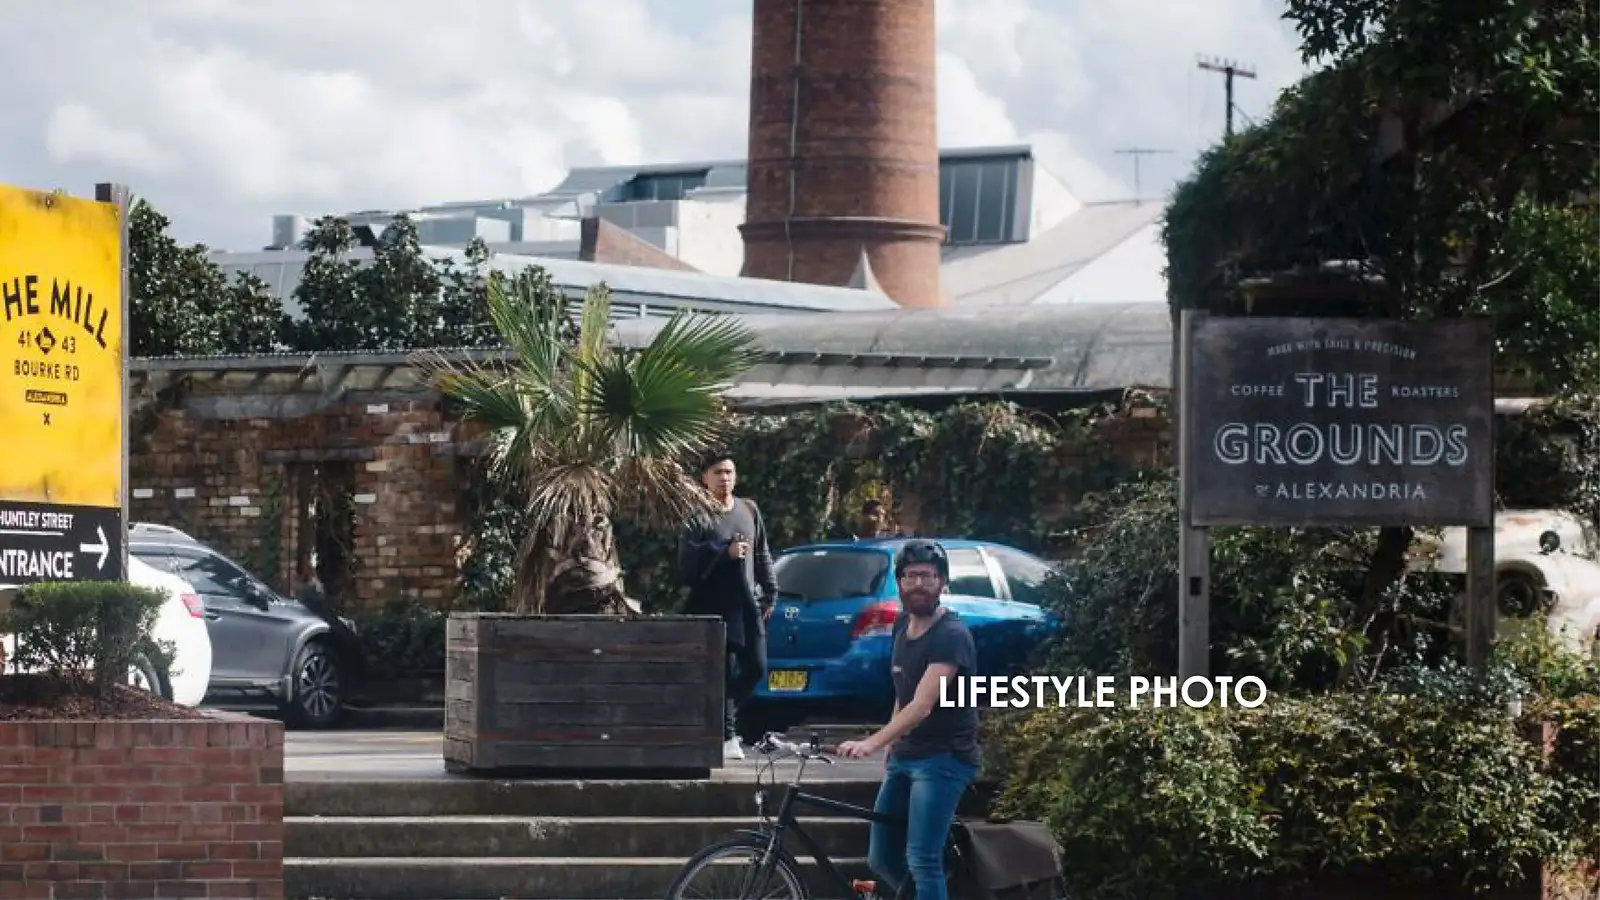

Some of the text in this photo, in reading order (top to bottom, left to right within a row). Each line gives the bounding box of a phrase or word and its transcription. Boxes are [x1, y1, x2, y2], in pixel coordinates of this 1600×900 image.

[50, 277, 109, 349] MILL
[18, 330, 76, 354] 41 43
[14, 360, 79, 380] BOURKE RD
[1231, 372, 1459, 408] COFFEE THE ROASTERS
[1214, 422, 1470, 466] GROUNDS
[1275, 482, 1428, 500] ALEXANDRIA
[0, 510, 73, 529] HUNTLEY STREET
[0, 549, 74, 578] NTRANCE
